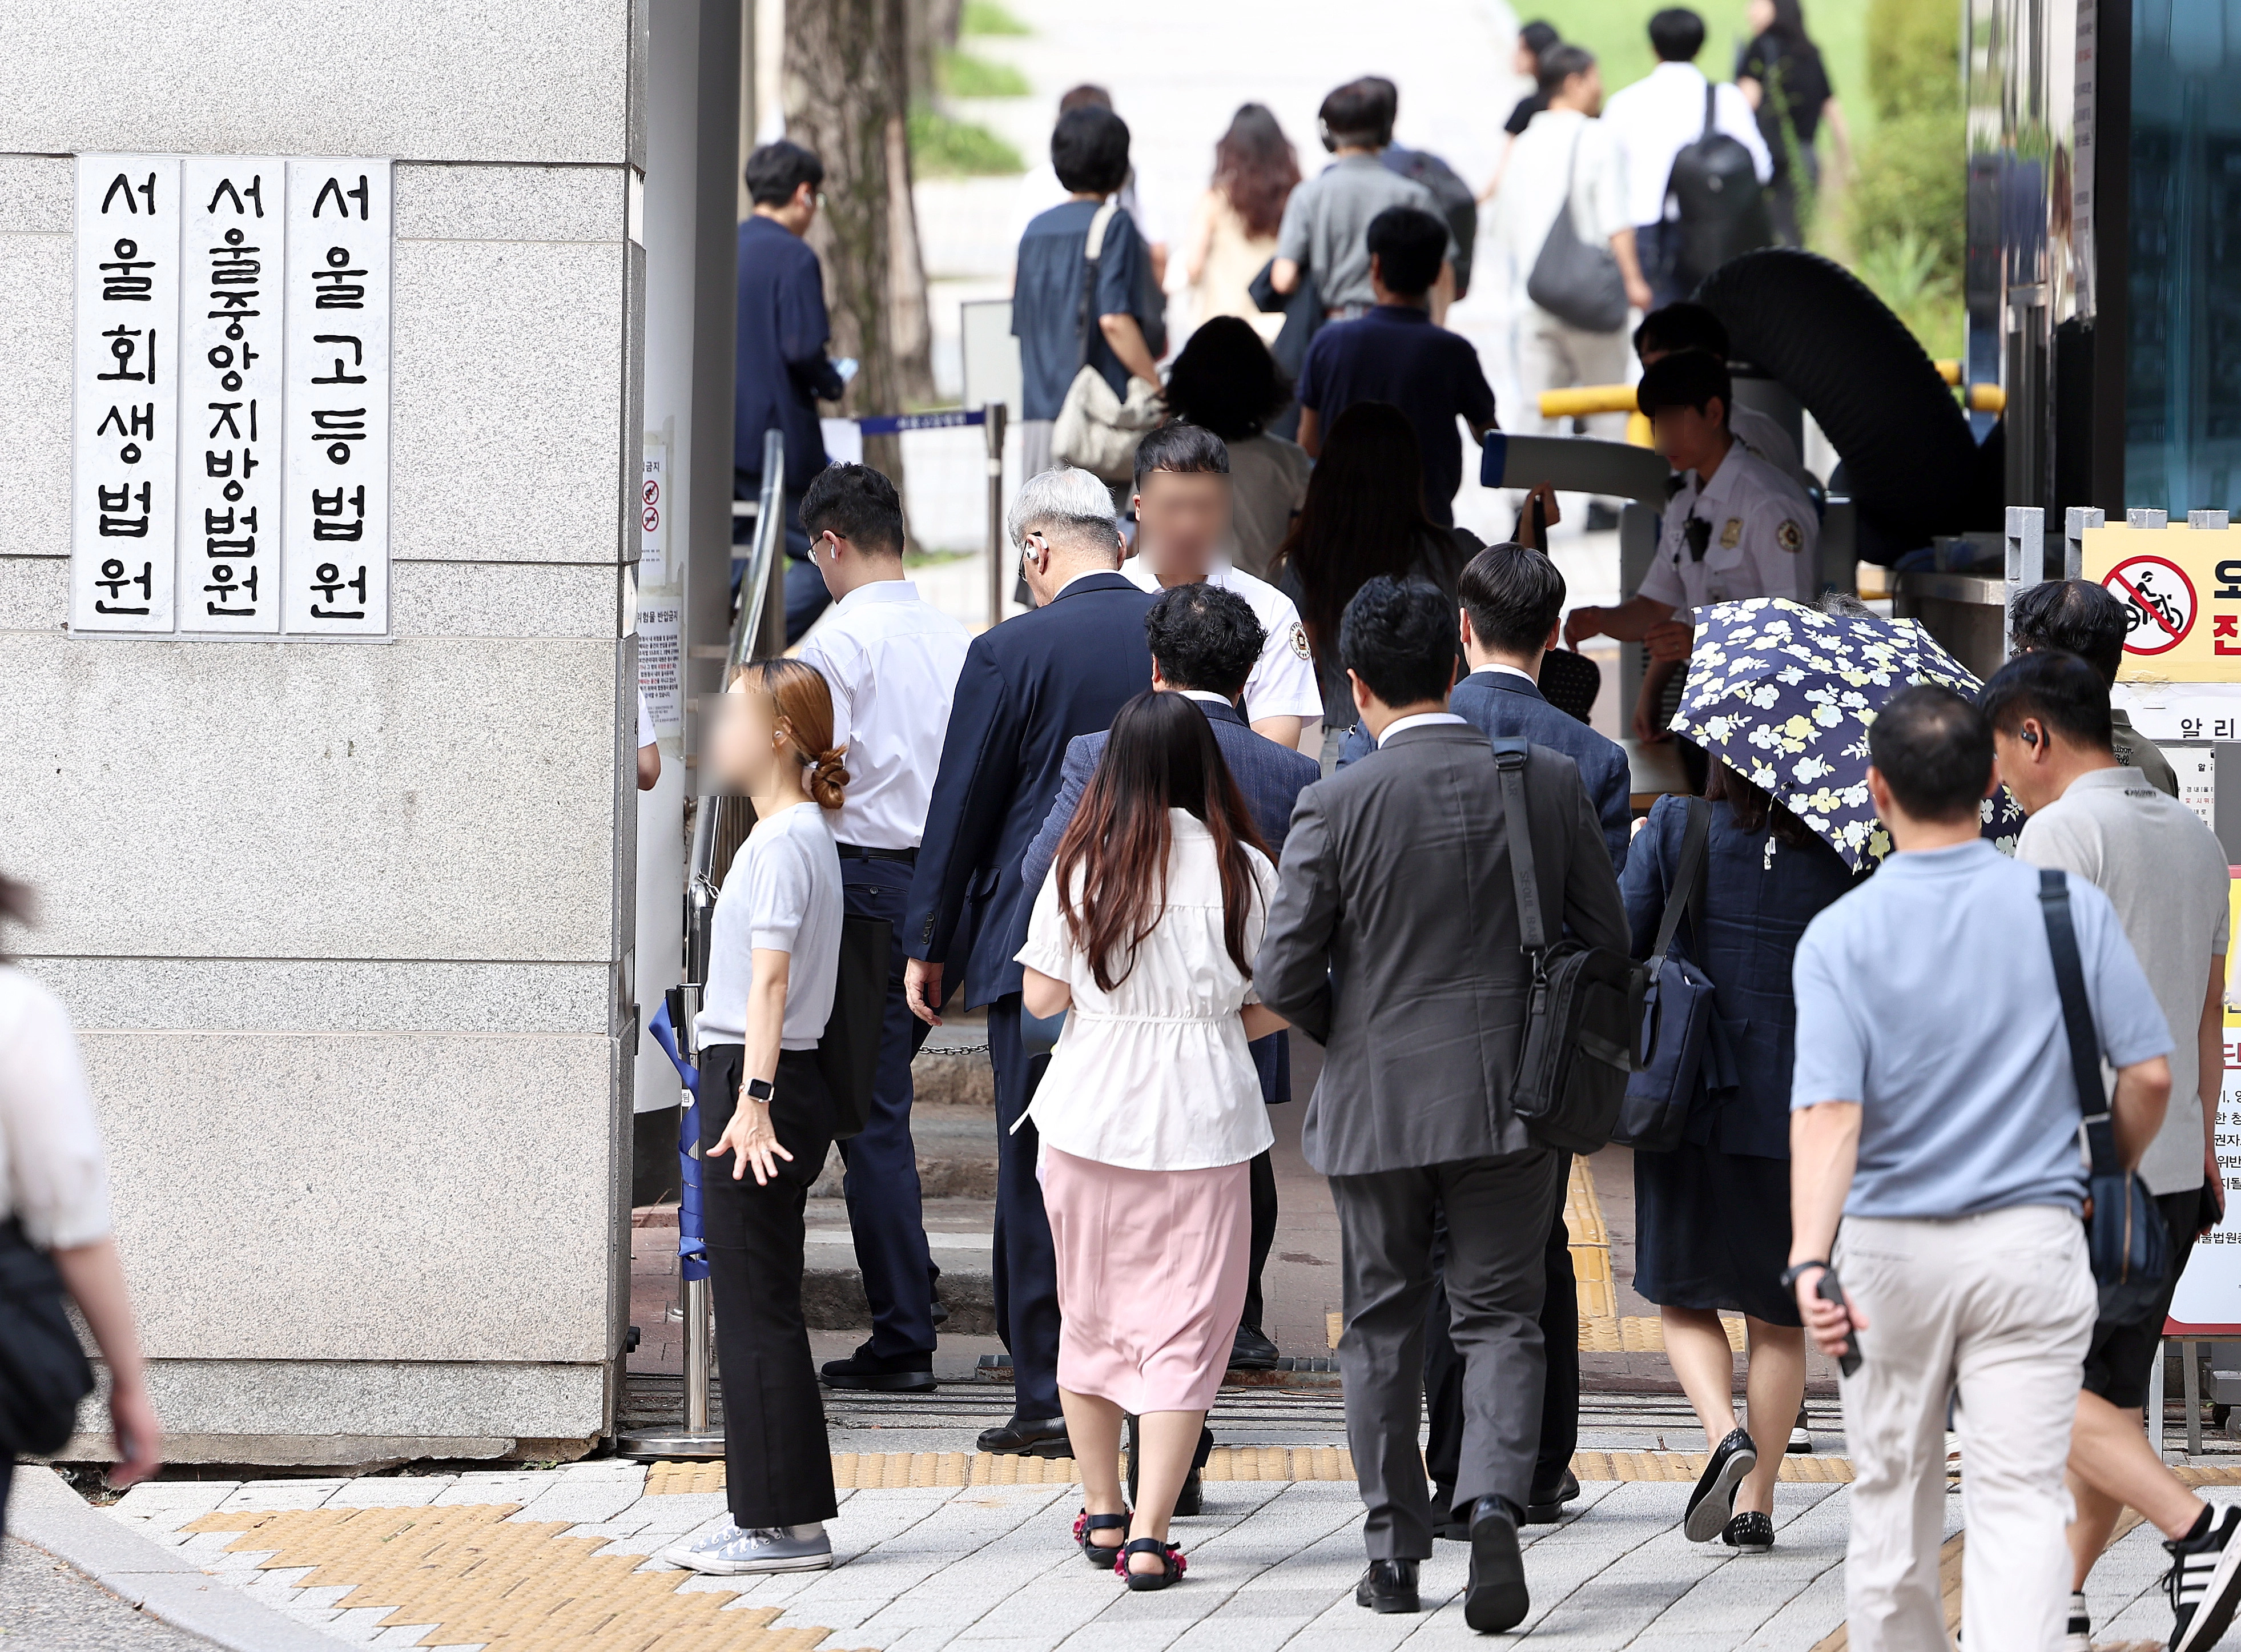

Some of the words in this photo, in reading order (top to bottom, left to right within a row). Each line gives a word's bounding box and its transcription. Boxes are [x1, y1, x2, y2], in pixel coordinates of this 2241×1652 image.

[95, 172, 156, 615] 서울회생법원
[204, 175, 264, 616] 서울중앙지방법원
[310, 175, 368, 619] 서울고등법원
[658, 610, 678, 622] 반입금지
[2113, 745, 2134, 754] albon
[1519, 870, 1534, 911] SEOUL
[2214, 1134, 2241, 1146] 권자
[2198, 1232, 2241, 1244] 울법원
